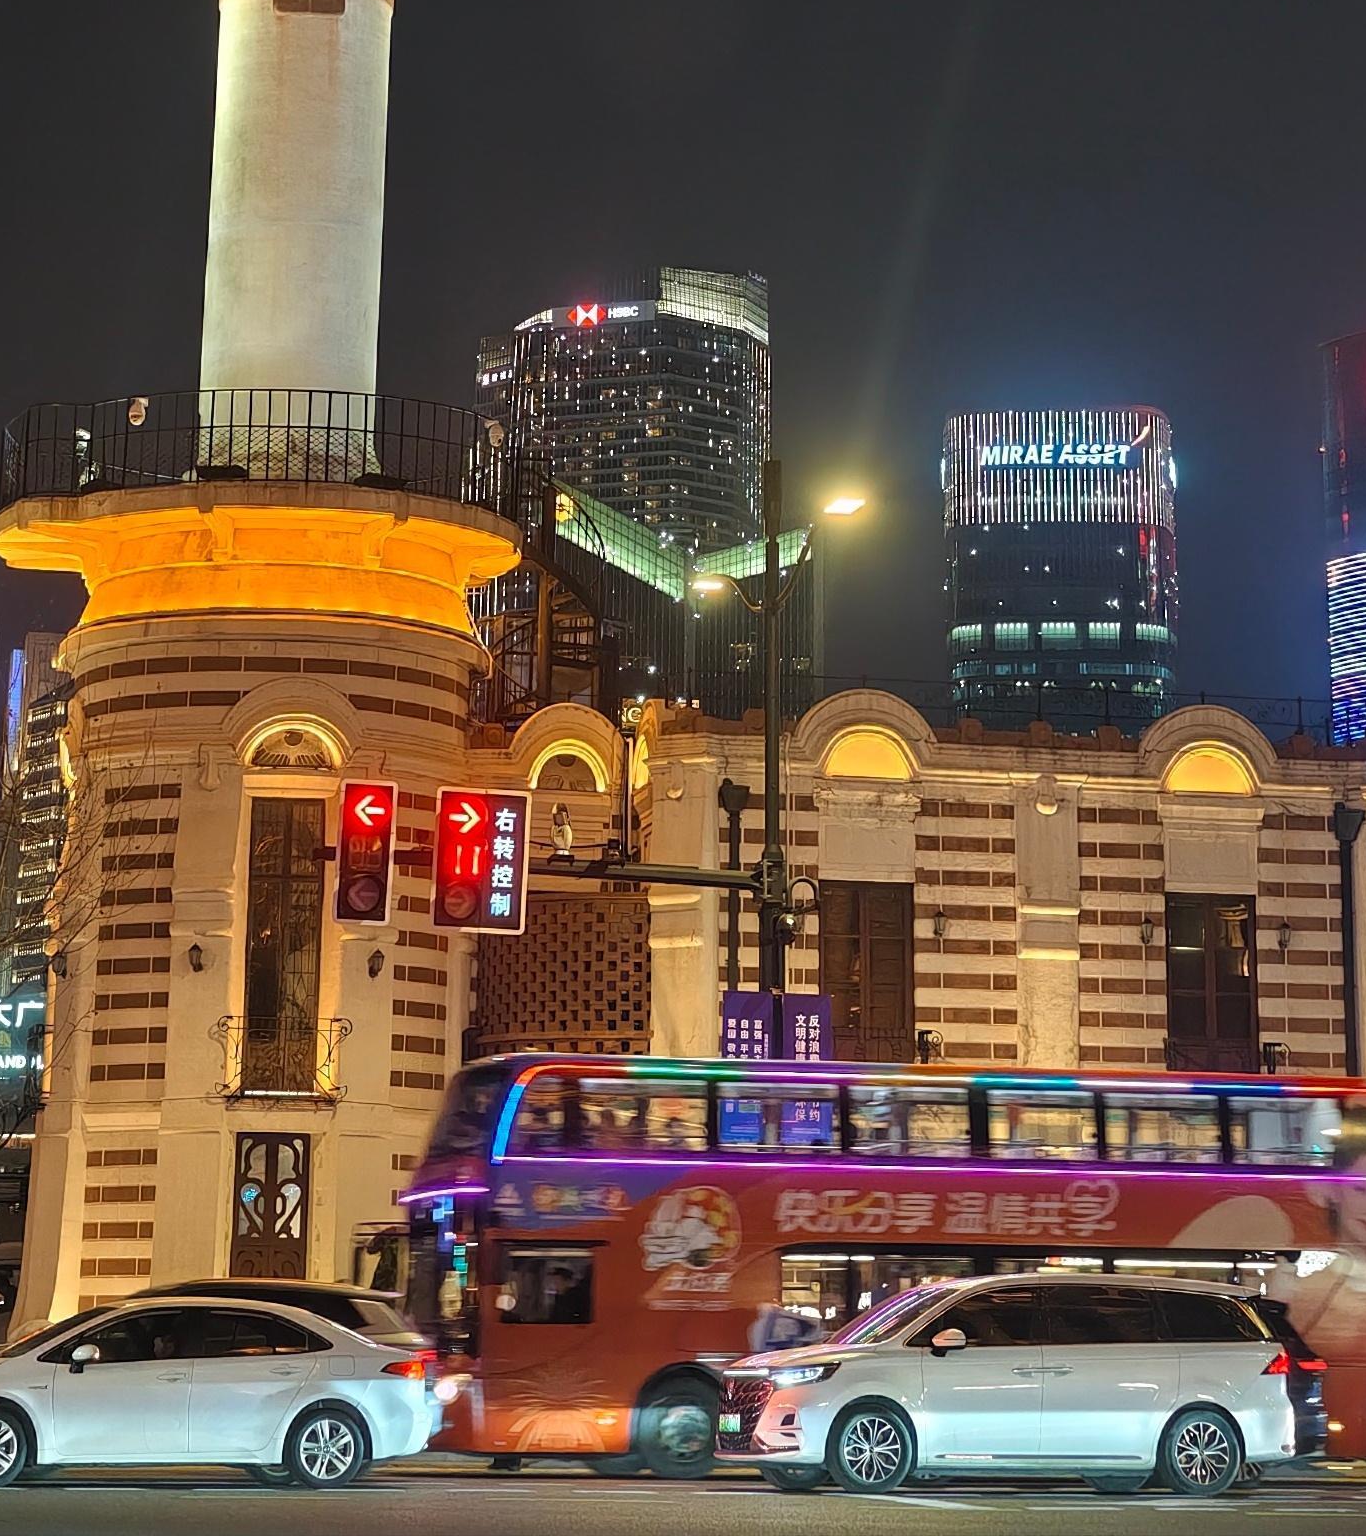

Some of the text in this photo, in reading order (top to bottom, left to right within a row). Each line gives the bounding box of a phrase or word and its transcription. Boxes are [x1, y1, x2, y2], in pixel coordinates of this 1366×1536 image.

[607, 306, 639, 320] HSBC
[980, 443, 1131, 466] MIRAE ASSET
[490, 808, 517, 917] 右转控制
[773, 1186, 1119, 1236] 快乐分享 温情共享
